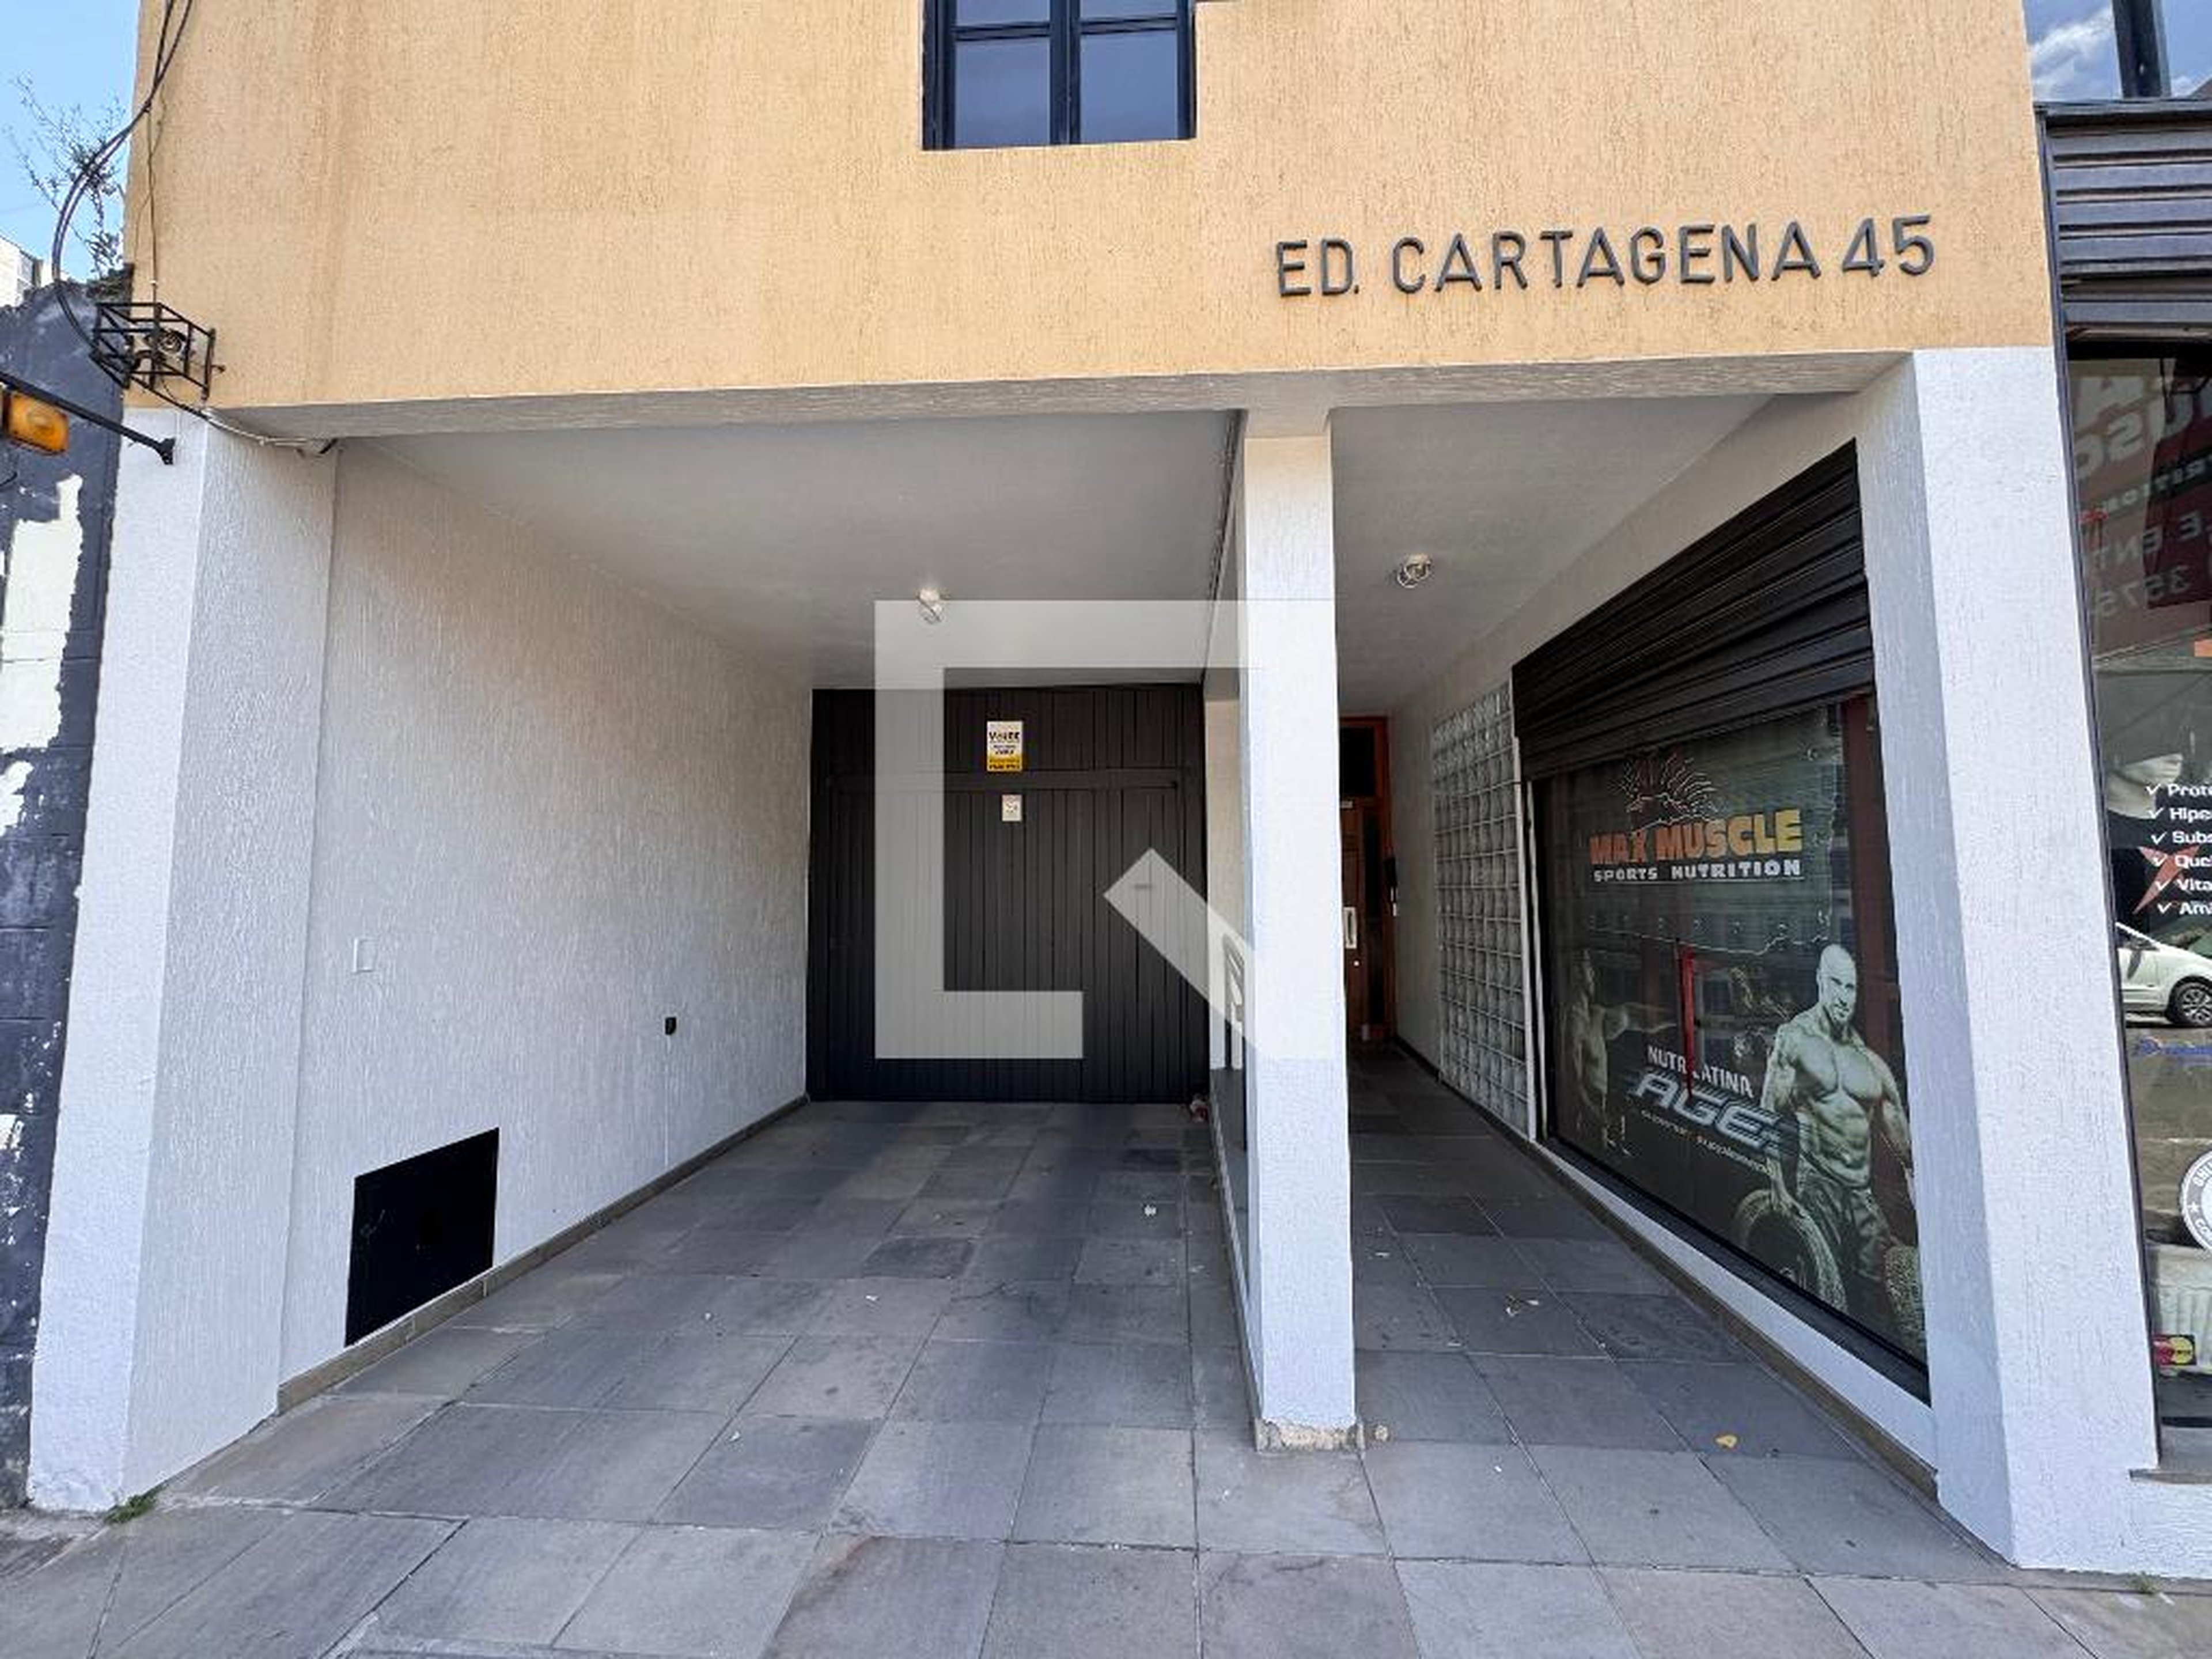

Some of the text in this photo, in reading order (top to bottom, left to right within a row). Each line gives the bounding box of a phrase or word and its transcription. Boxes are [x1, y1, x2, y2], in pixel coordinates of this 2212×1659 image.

[1275, 214, 1936, 297] ED. CARTAGENA 45
[1589, 809, 1802, 865] MAX MUSCLE
[1593, 859, 1801, 882] SPORTS NUTRITION
